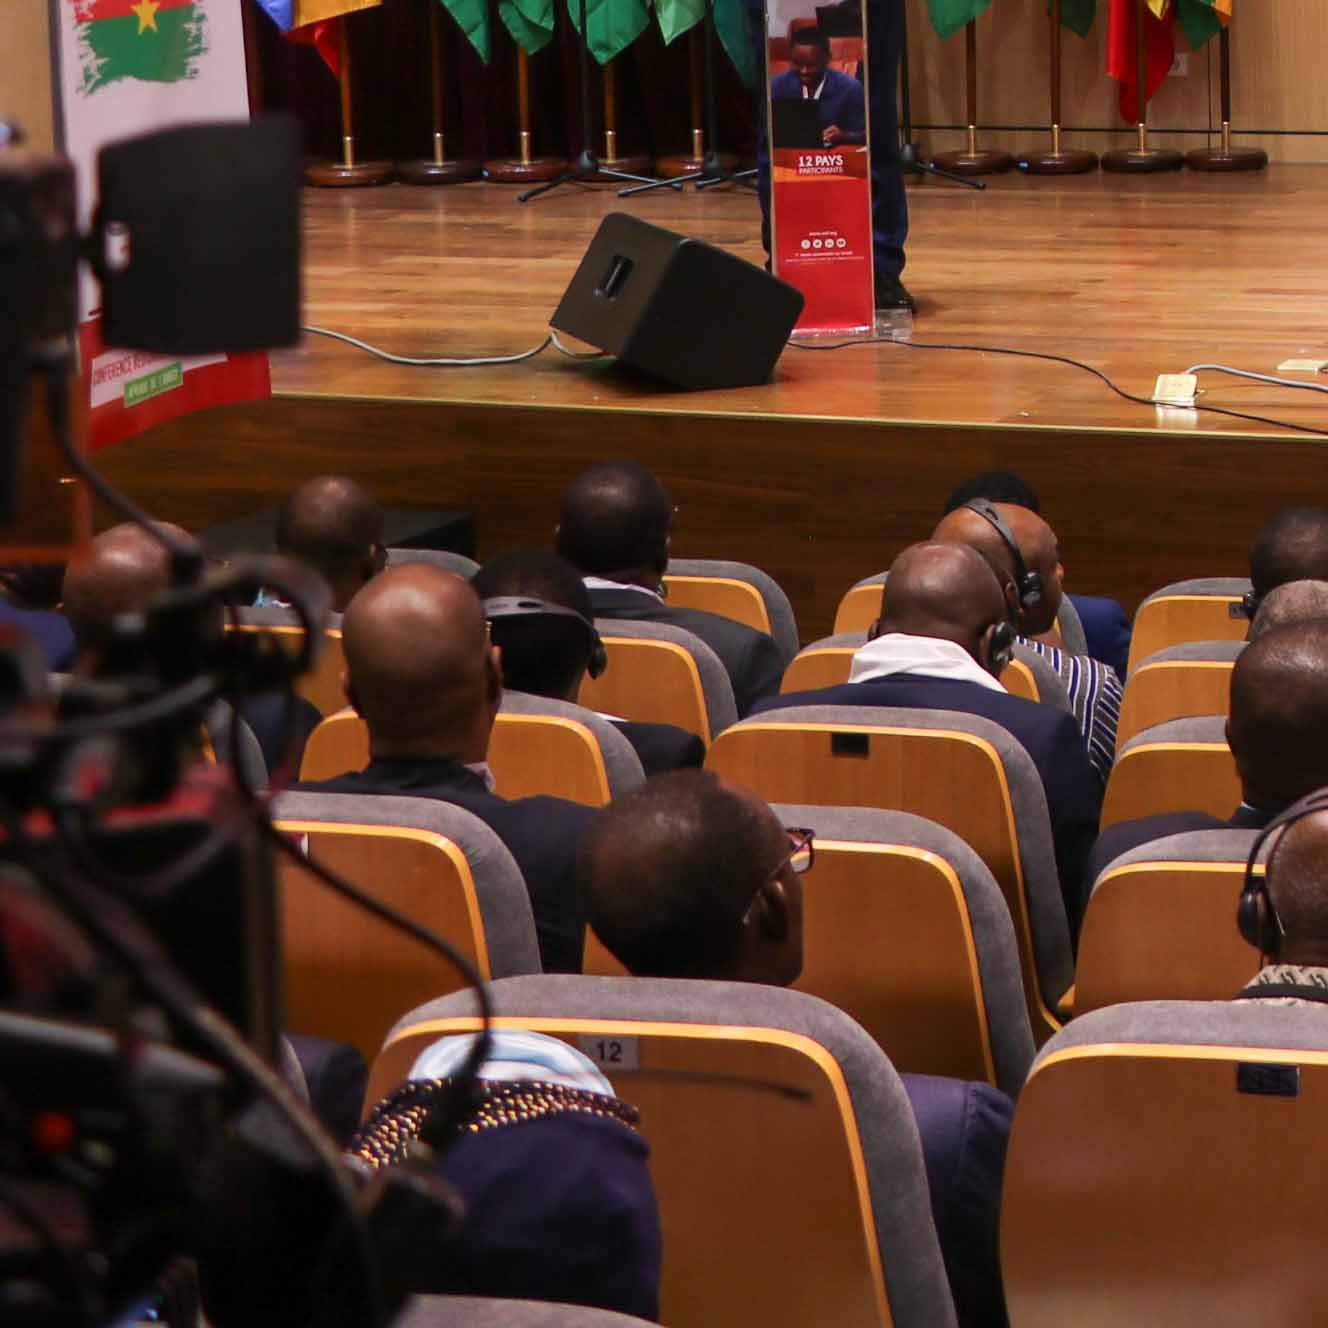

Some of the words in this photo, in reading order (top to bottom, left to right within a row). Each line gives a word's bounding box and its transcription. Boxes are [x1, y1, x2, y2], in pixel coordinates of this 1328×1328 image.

[798, 156, 813, 167] 12
[815, 155, 844, 167] PAYS
[596, 1041, 622, 1062] 12
